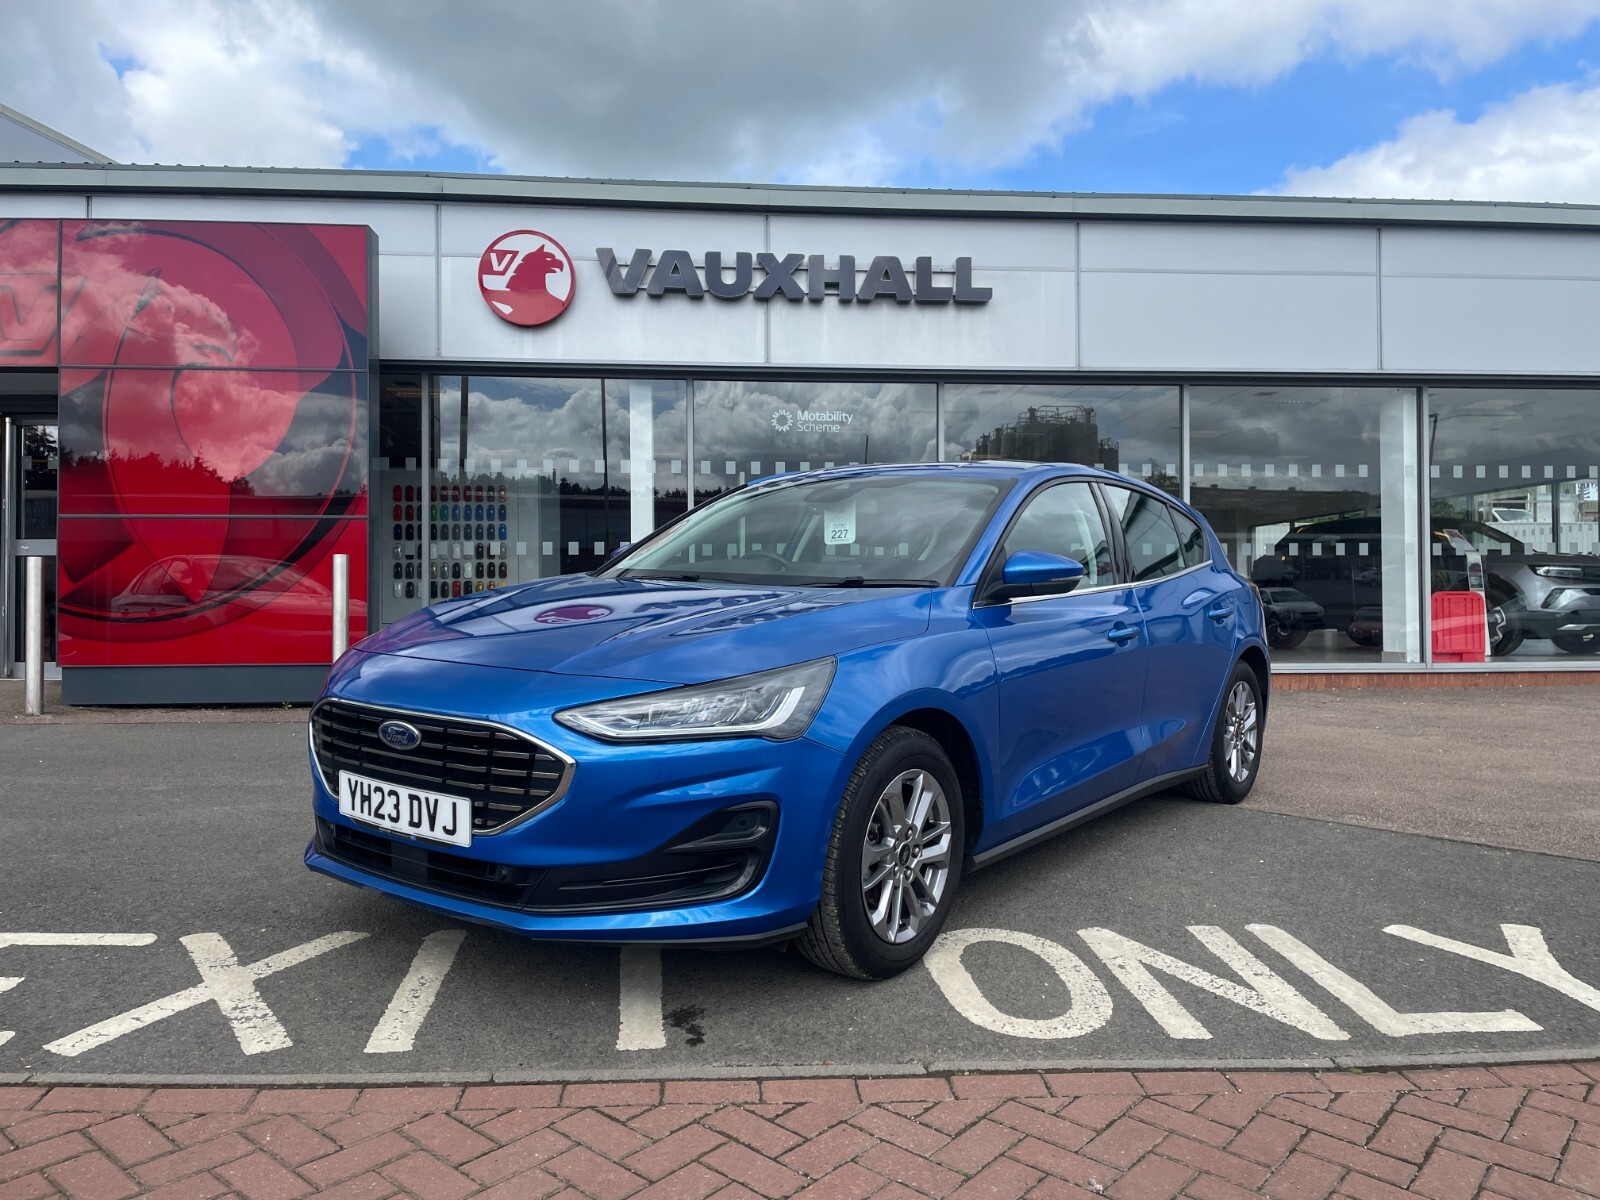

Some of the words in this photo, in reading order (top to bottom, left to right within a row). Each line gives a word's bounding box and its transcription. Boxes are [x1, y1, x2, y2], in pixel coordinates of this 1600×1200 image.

[596, 247, 993, 304] VAUXHALL
[797, 410, 853, 424] Motability
[797, 421, 840, 432] Scheme
[831, 529, 848, 539] 227
[386, 726, 409, 743] Ford
[347, 777, 400, 823] YH23
[407, 793, 457, 836] DVJ
[0, 929, 666, 1057] XI
